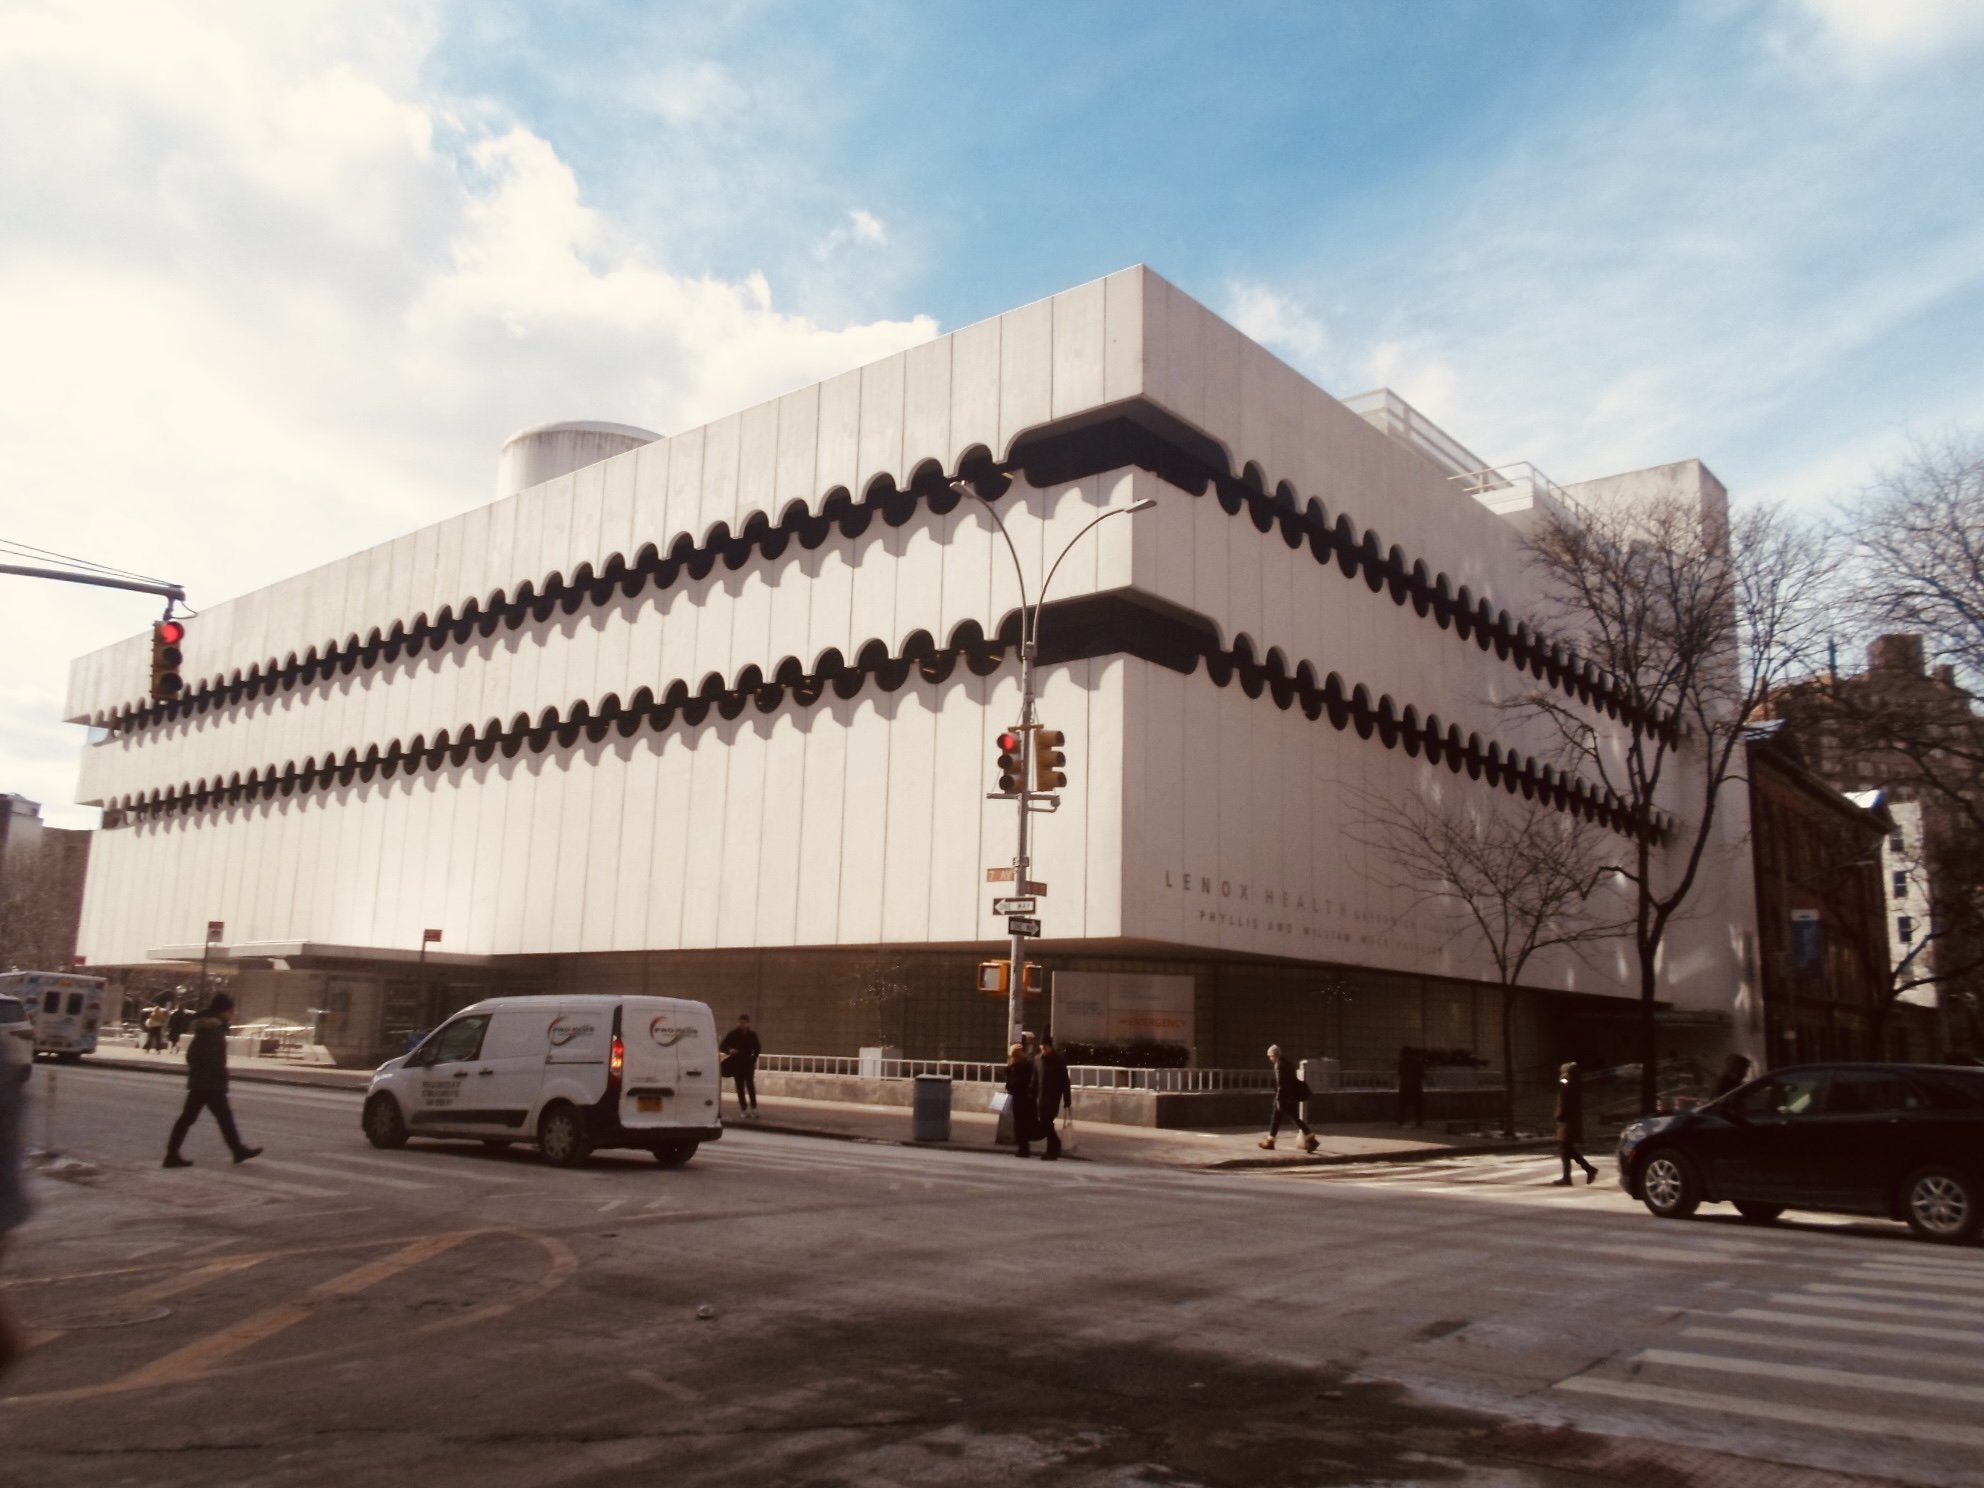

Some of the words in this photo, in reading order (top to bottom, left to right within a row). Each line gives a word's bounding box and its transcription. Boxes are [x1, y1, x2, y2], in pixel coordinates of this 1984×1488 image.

[1165, 870, 1249, 901] LENOX
[1265, 889, 1347, 916] HEALTH
[1199, 910, 1258, 930] PHYLLIS
[1267, 922, 1292, 934] AND
